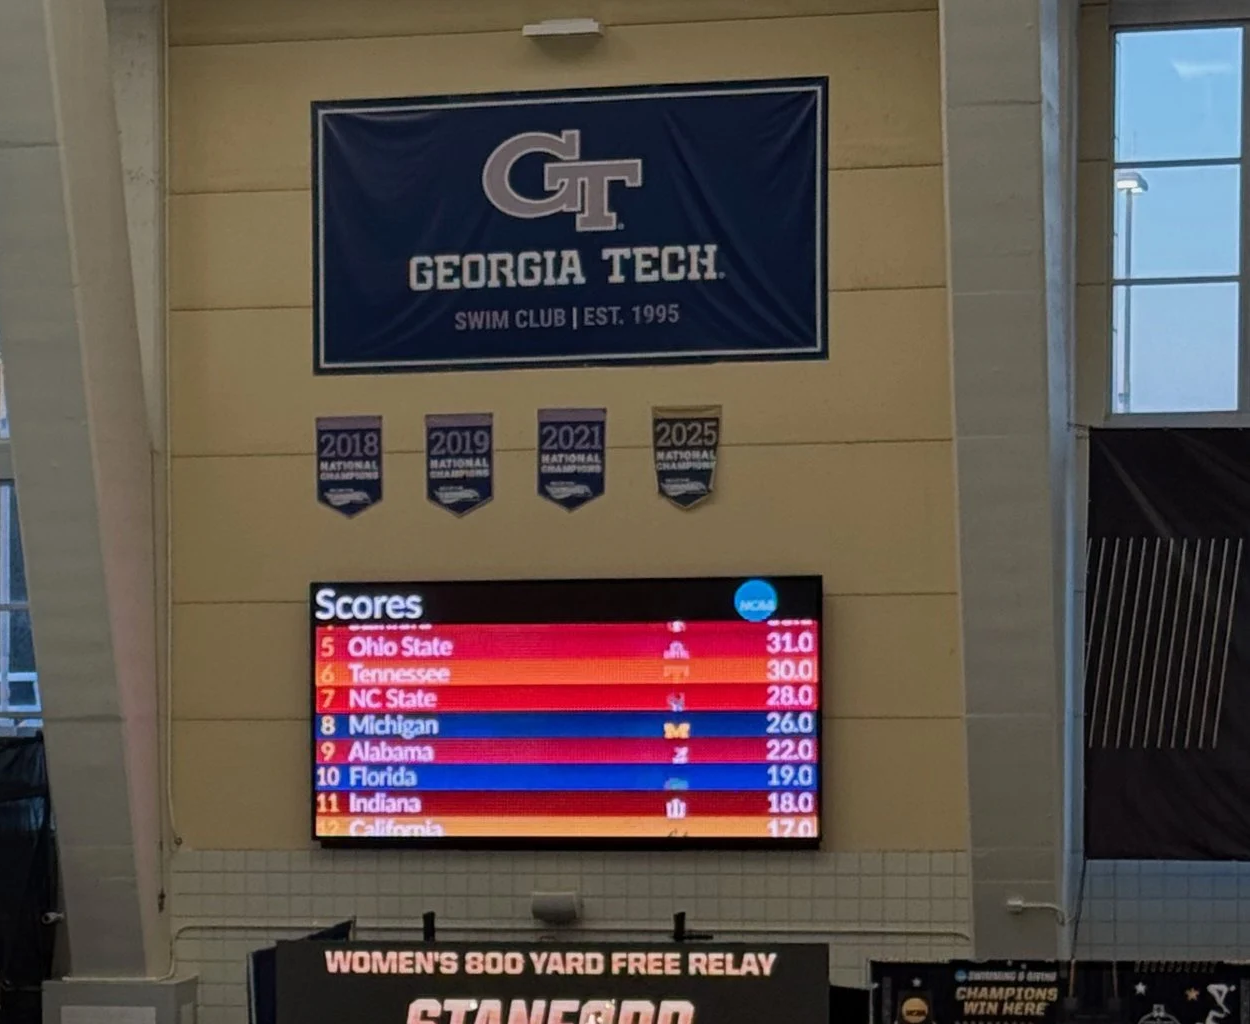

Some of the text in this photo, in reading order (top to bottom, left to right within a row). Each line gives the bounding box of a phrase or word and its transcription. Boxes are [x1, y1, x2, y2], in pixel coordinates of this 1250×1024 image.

[409, 243, 719, 291] GEORGIA TECH
[454, 303, 681, 331] SWIM CLUB EST. 1995
[320, 432, 379, 457] 2018
[429, 430, 489, 455] 2019
[542, 425, 601, 450] 2021
[656, 421, 717, 447] 2025
[320, 460, 379, 471] NATIONAL
[429, 457, 489, 469] NATIONAL
[541, 453, 601, 464] NATIONAL
[656, 450, 716, 461] NATIONAL
[320, 471, 379, 481] CHAMPIONS
[315, 588, 423, 620] Scores
[321, 632, 813, 657] 5 Ohio State 31.0
[321, 664, 335, 683] 6
[348, 663, 450, 683] Tennessee
[766, 660, 813, 681] 30.0
[321, 685, 813, 709] 7 NC State 28.0
[320, 715, 335, 735] 8
[350, 714, 439, 739] Michigan
[766, 712, 814, 733] 26.0
[321, 739, 813, 762] 9 Alabama 22.0
[317, 765, 813, 787] 10 Florida 19.0
[317, 792, 814, 813] 11 Indiana 18.0
[349, 819, 445, 837] California
[767, 819, 814, 837] 17.0
[325, 950, 777, 976] WOMEN'S 800 YARD FREE RELAY
[956, 986, 1058, 1001] CHAMPIONS
[964, 1001, 1047, 1016] WIN HERE
